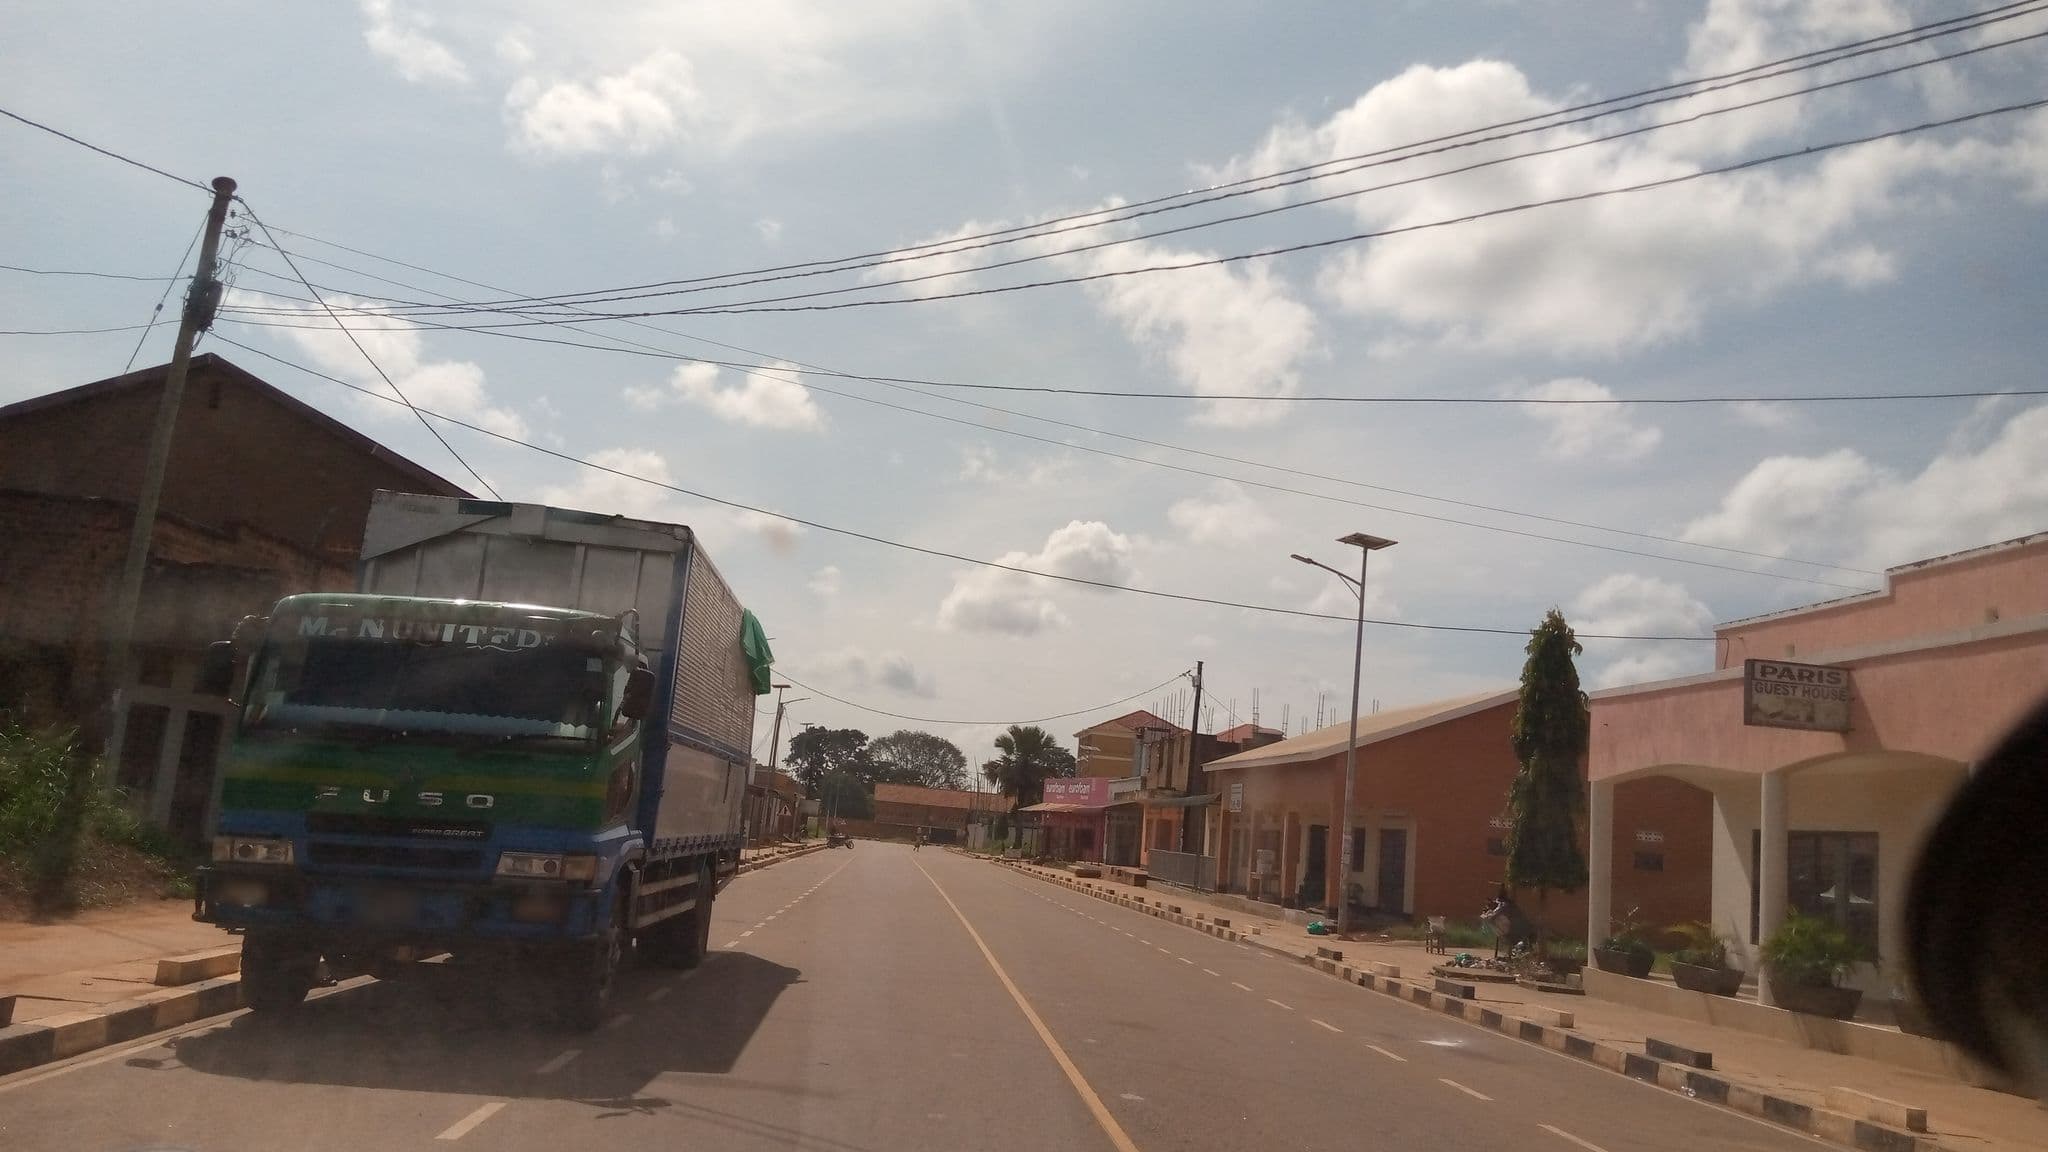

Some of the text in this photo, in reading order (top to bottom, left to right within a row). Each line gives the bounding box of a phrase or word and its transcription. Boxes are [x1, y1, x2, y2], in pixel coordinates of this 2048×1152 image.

[1760, 664, 1842, 684] PARIS
[1754, 682, 1849, 702] GUEST HOUSE
[315, 786, 495, 808] FUSO
